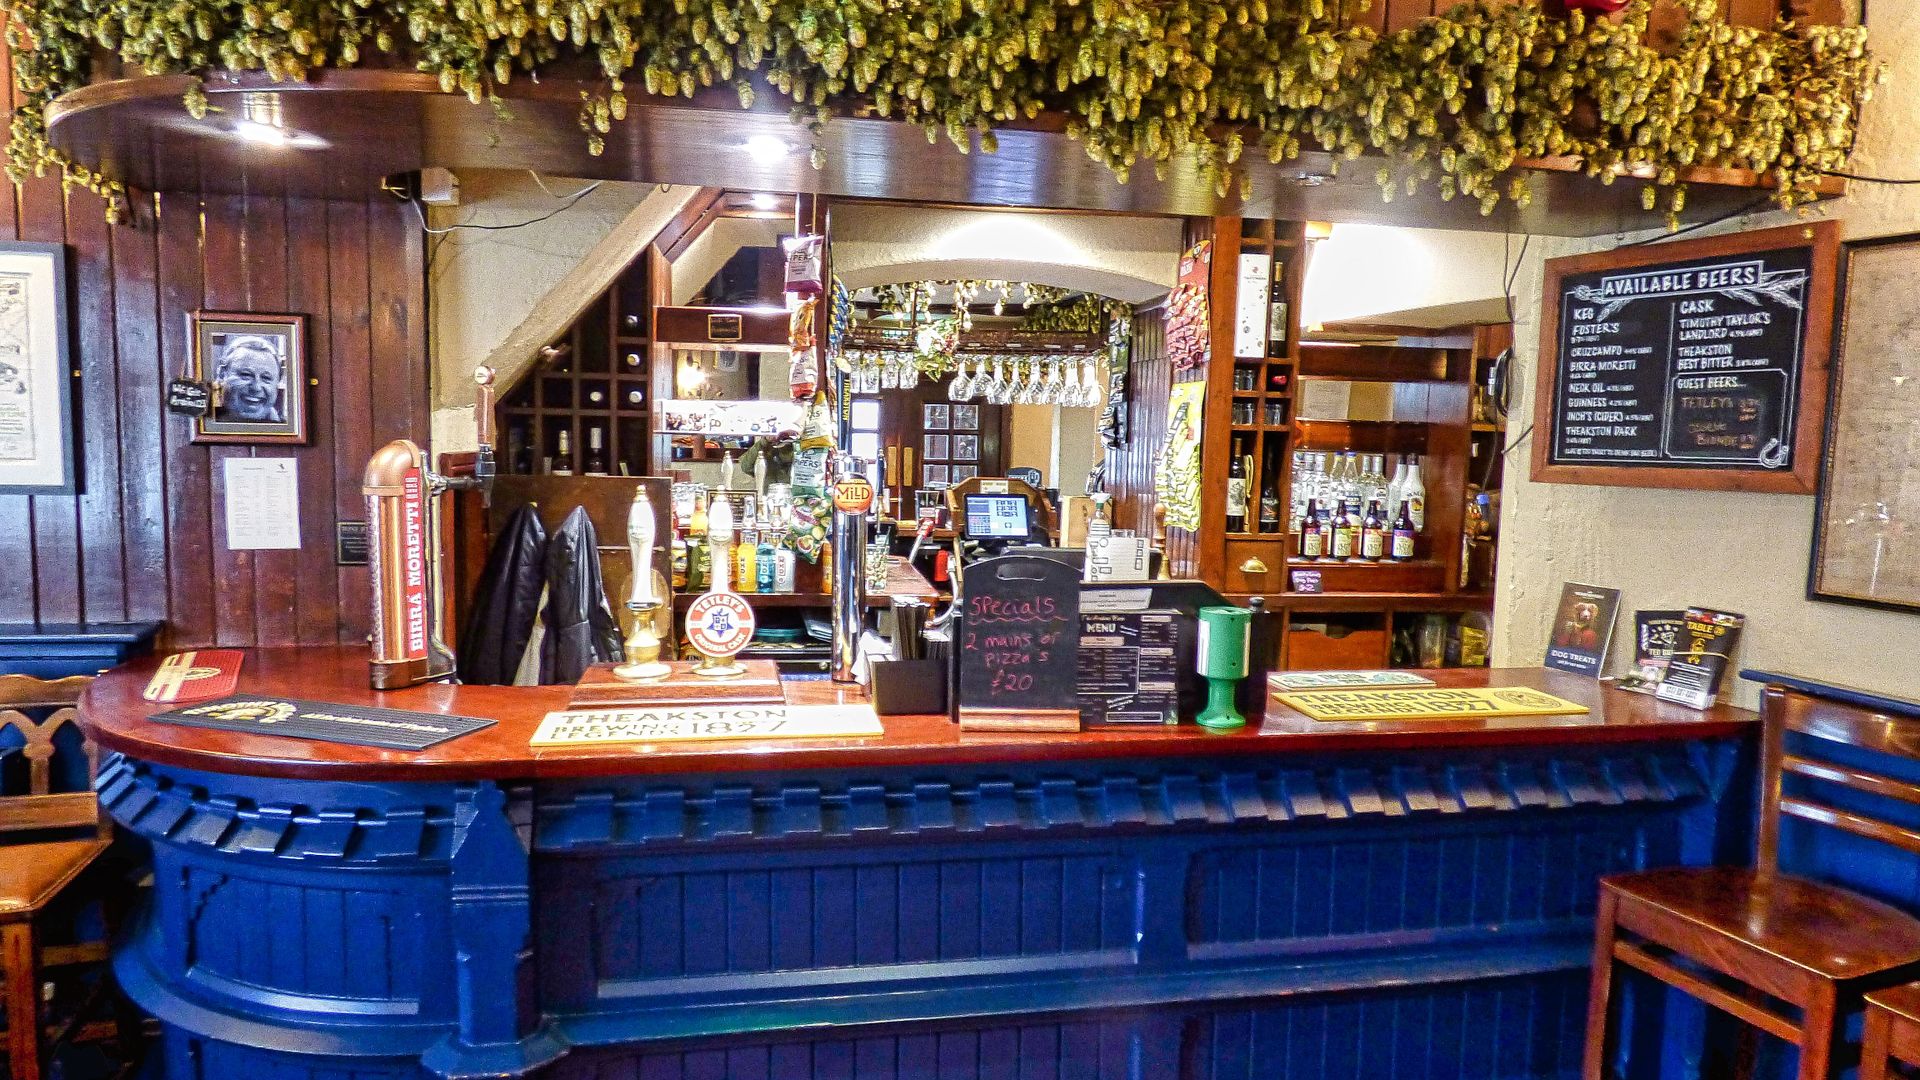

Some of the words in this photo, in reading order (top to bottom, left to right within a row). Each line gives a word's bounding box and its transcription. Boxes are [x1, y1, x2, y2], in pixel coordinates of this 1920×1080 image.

[1605, 274, 1691, 297] AVAILABLE
[1699, 266, 1756, 288] BEERS
[1679, 299, 1714, 314] CASK
[1573, 307, 1595, 320] KEG
[1679, 316, 1724, 329] TIMOTHY
[1725, 312, 1771, 327] TAYLOR'S
[1572, 322, 1621, 336] FOSTER'S
[1678, 327, 1728, 341] LANDLORD
[1570, 345, 1623, 357] CRUZCAMPO
[1677, 344, 1732, 357] THEAKSTON
[1569, 361, 1597, 372] BIRRA
[1598, 360, 1636, 371] MORETTI
[1677, 357, 1702, 371] BEST
[1702, 356, 1734, 369] BITTER
[1568, 383, 1590, 393] NECK
[1592, 382, 1606, 393] OIL
[1677, 378, 1704, 390] GUEST
[1568, 397, 1607, 408] GUINNESS
[1566, 411, 1592, 422] INCH'S
[1594, 411, 1624, 423] (CIDER)
[1565, 426, 1612, 437] THEAKSTON
[1613, 426, 1637, 437] DARK
[837, 487, 870, 500] MiLD
[405, 501, 422, 587] MORETTI
[694, 596, 745, 613] TETLEY'S
[409, 594, 424, 652] BIRRA
[1086, 623, 1116, 633] MENU
[965, 632, 979, 650] 2
[984, 632, 1032, 648] mains
[1551, 650, 1569, 659] DOG
[1569, 653, 1596, 665] TREATS
[1290, 691, 1481, 703] THEAKSTON
[1308, 702, 1411, 710] BREWING
[1415, 700, 1500, 713] 1827
[1318, 707, 1425, 715] LEGENDS
[562, 709, 787, 725] THEAKSTON
[554, 722, 681, 734] BREWING
